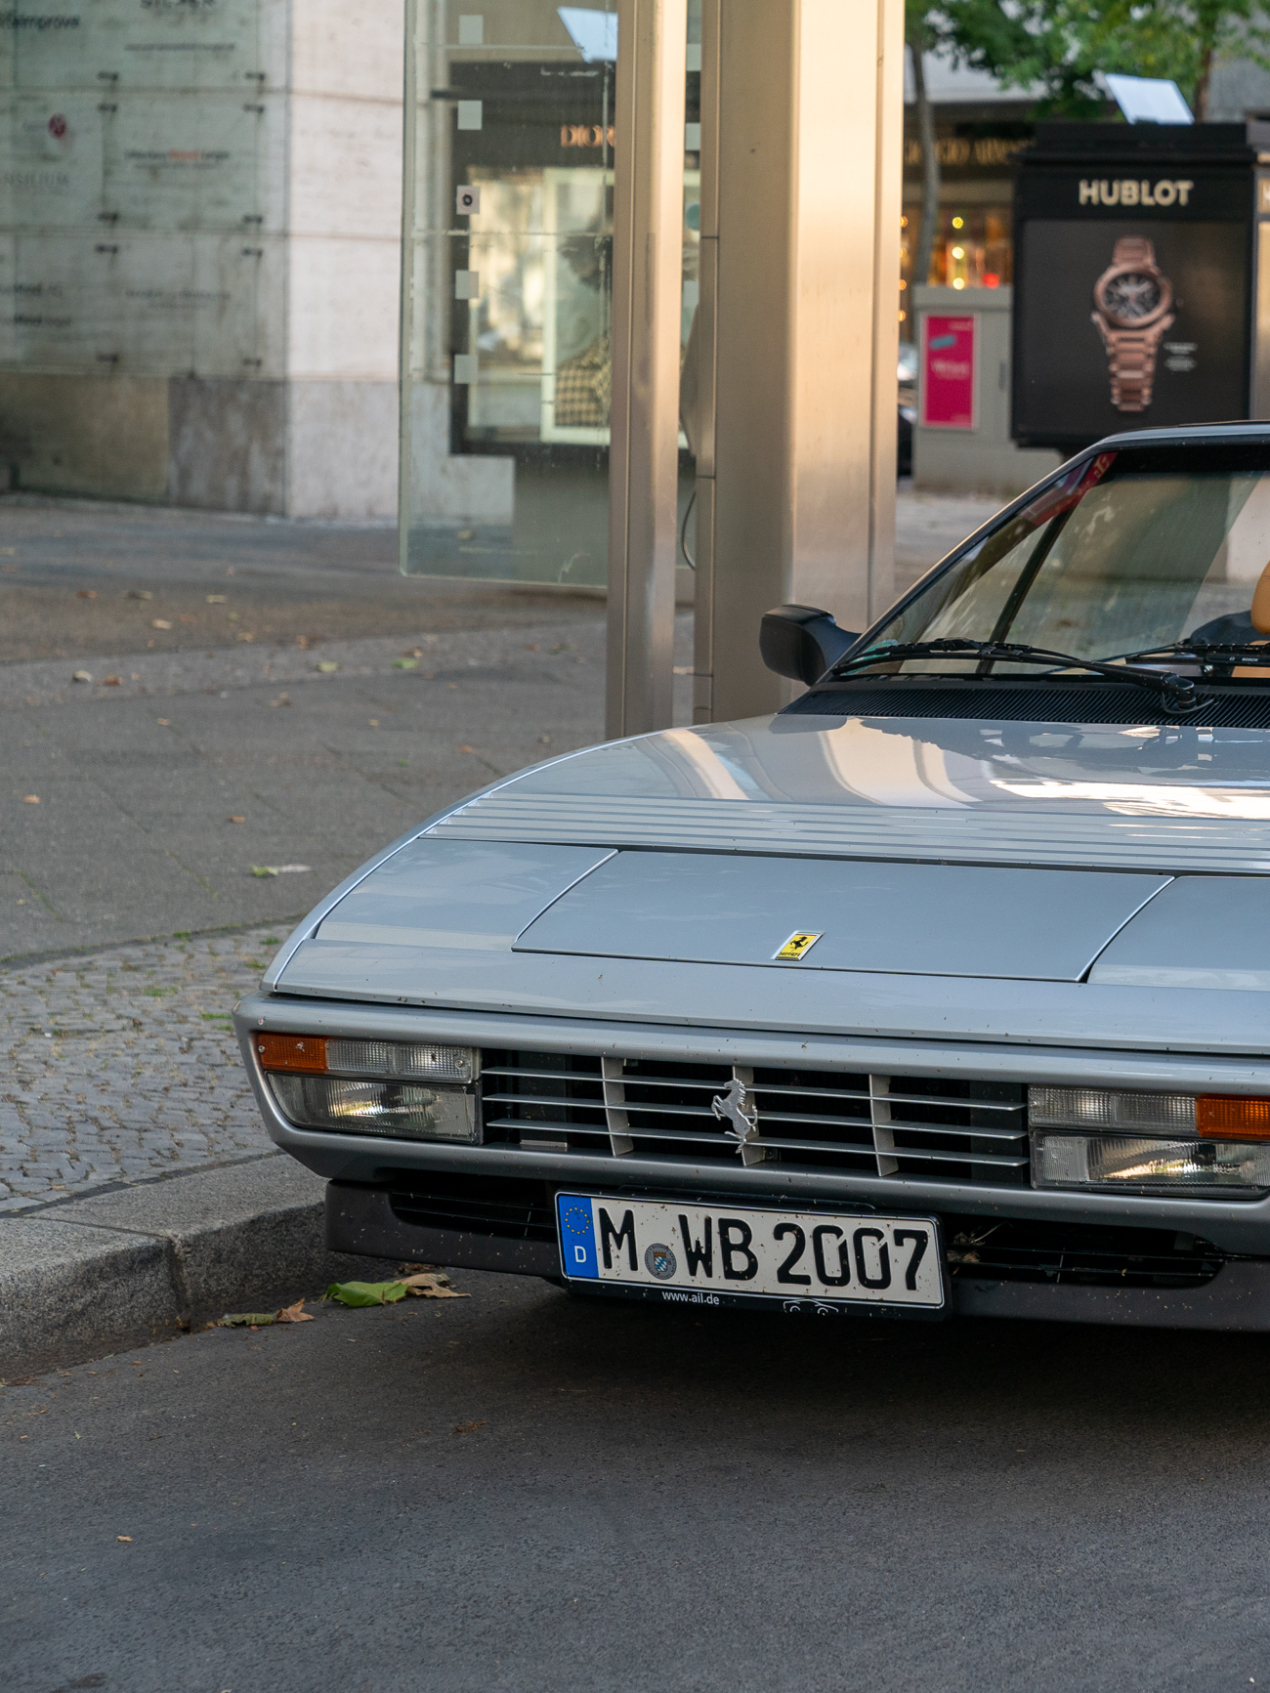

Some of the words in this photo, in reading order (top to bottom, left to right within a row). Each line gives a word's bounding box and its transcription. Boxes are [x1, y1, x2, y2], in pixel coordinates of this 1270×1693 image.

[1078, 179, 1194, 206] HUBLOT
[573, 1245, 588, 1264] D
[598, 1207, 638, 1272] M
[678, 1213, 759, 1282] WB
[773, 1222, 929, 1291] 2007
[661, 1290, 720, 1305] www.ail.de
